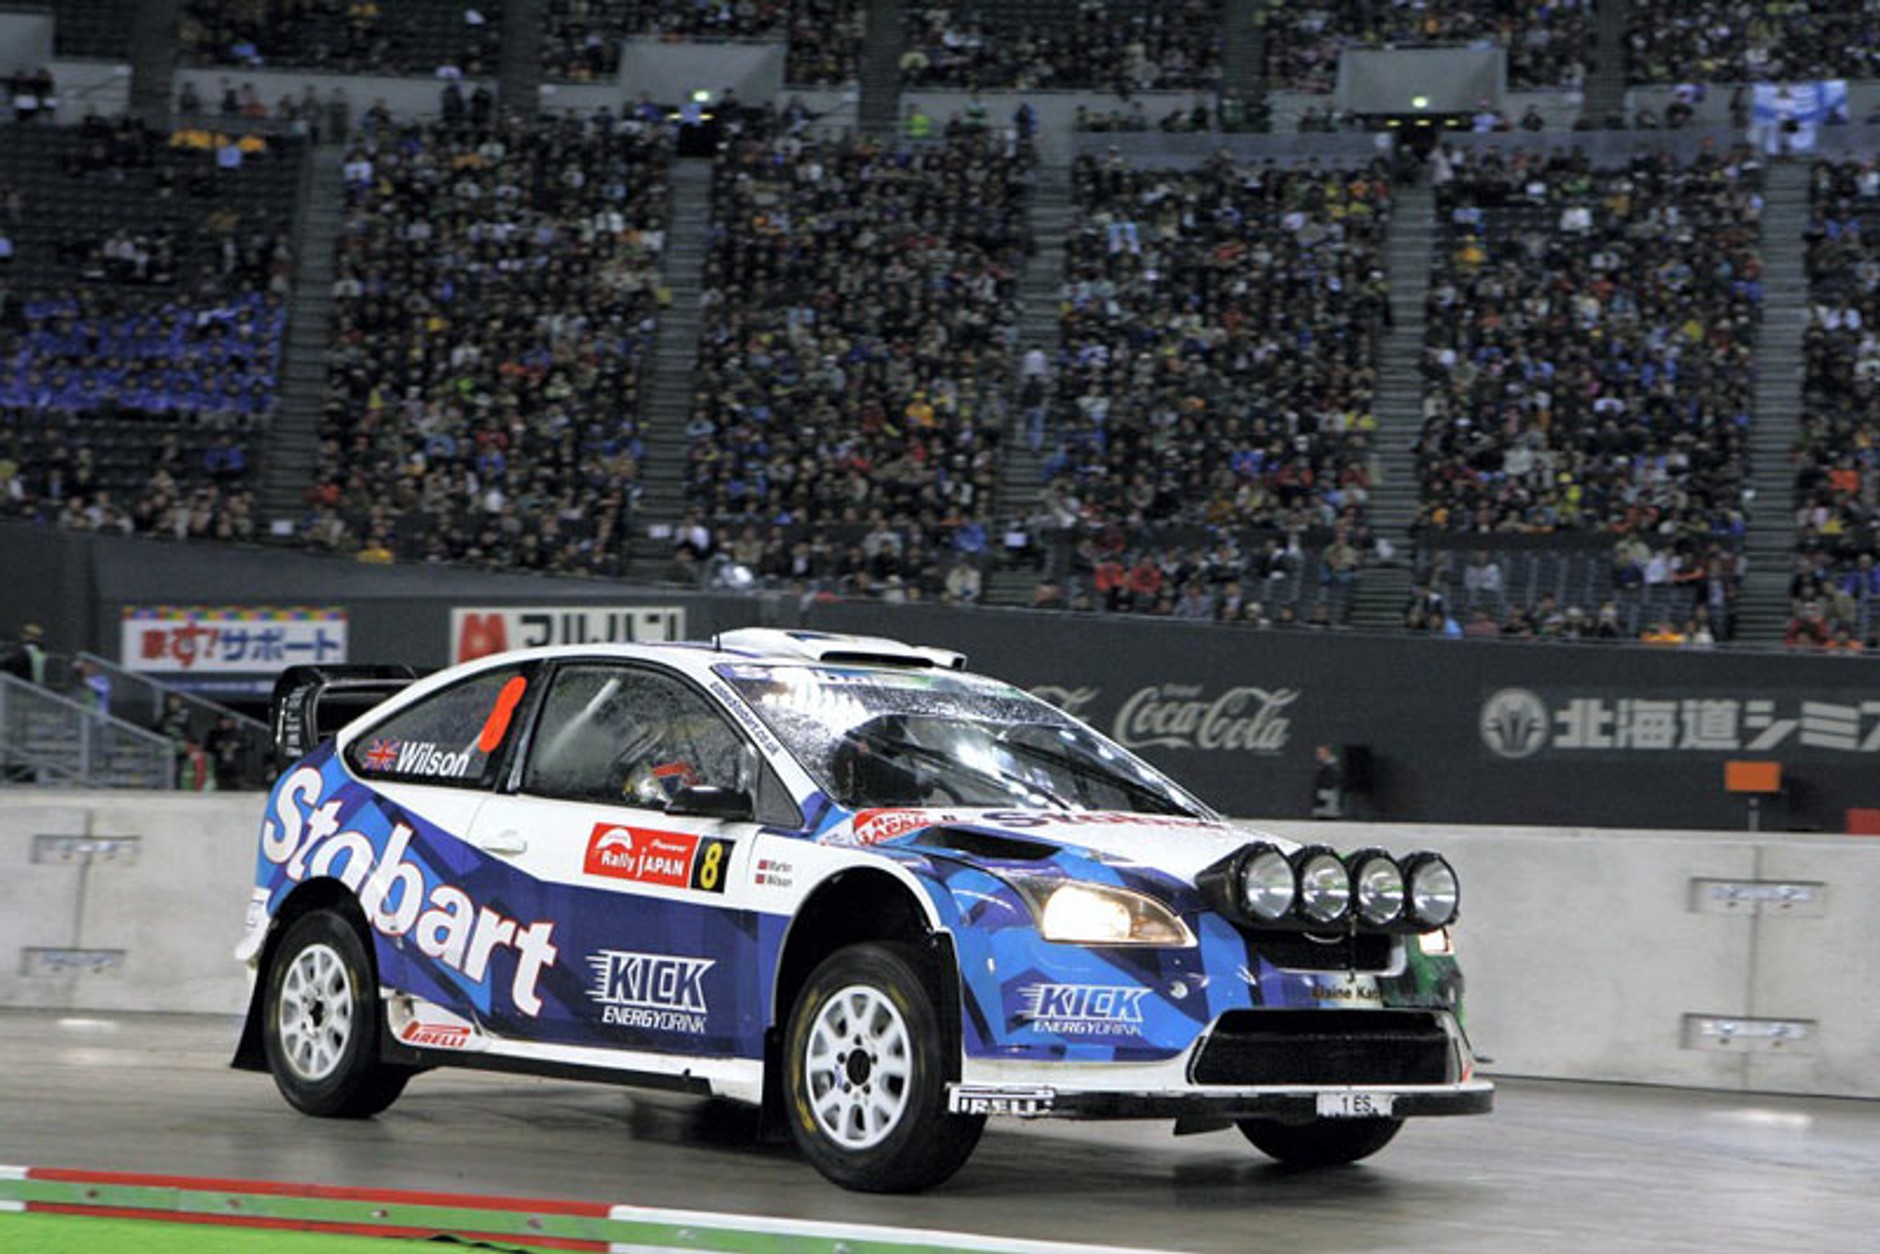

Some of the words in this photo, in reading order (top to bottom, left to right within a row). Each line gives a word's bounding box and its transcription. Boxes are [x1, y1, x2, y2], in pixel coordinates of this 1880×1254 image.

[396, 740, 470, 777] Wilson
[600, 850, 636, 872] Rally
[700, 842, 723, 890] 8
[262, 766, 558, 1018] Stobart
[604, 952, 716, 1013] KICK
[1034, 984, 1153, 1022] KICK
[401, 1020, 471, 1047] PIRELLI
